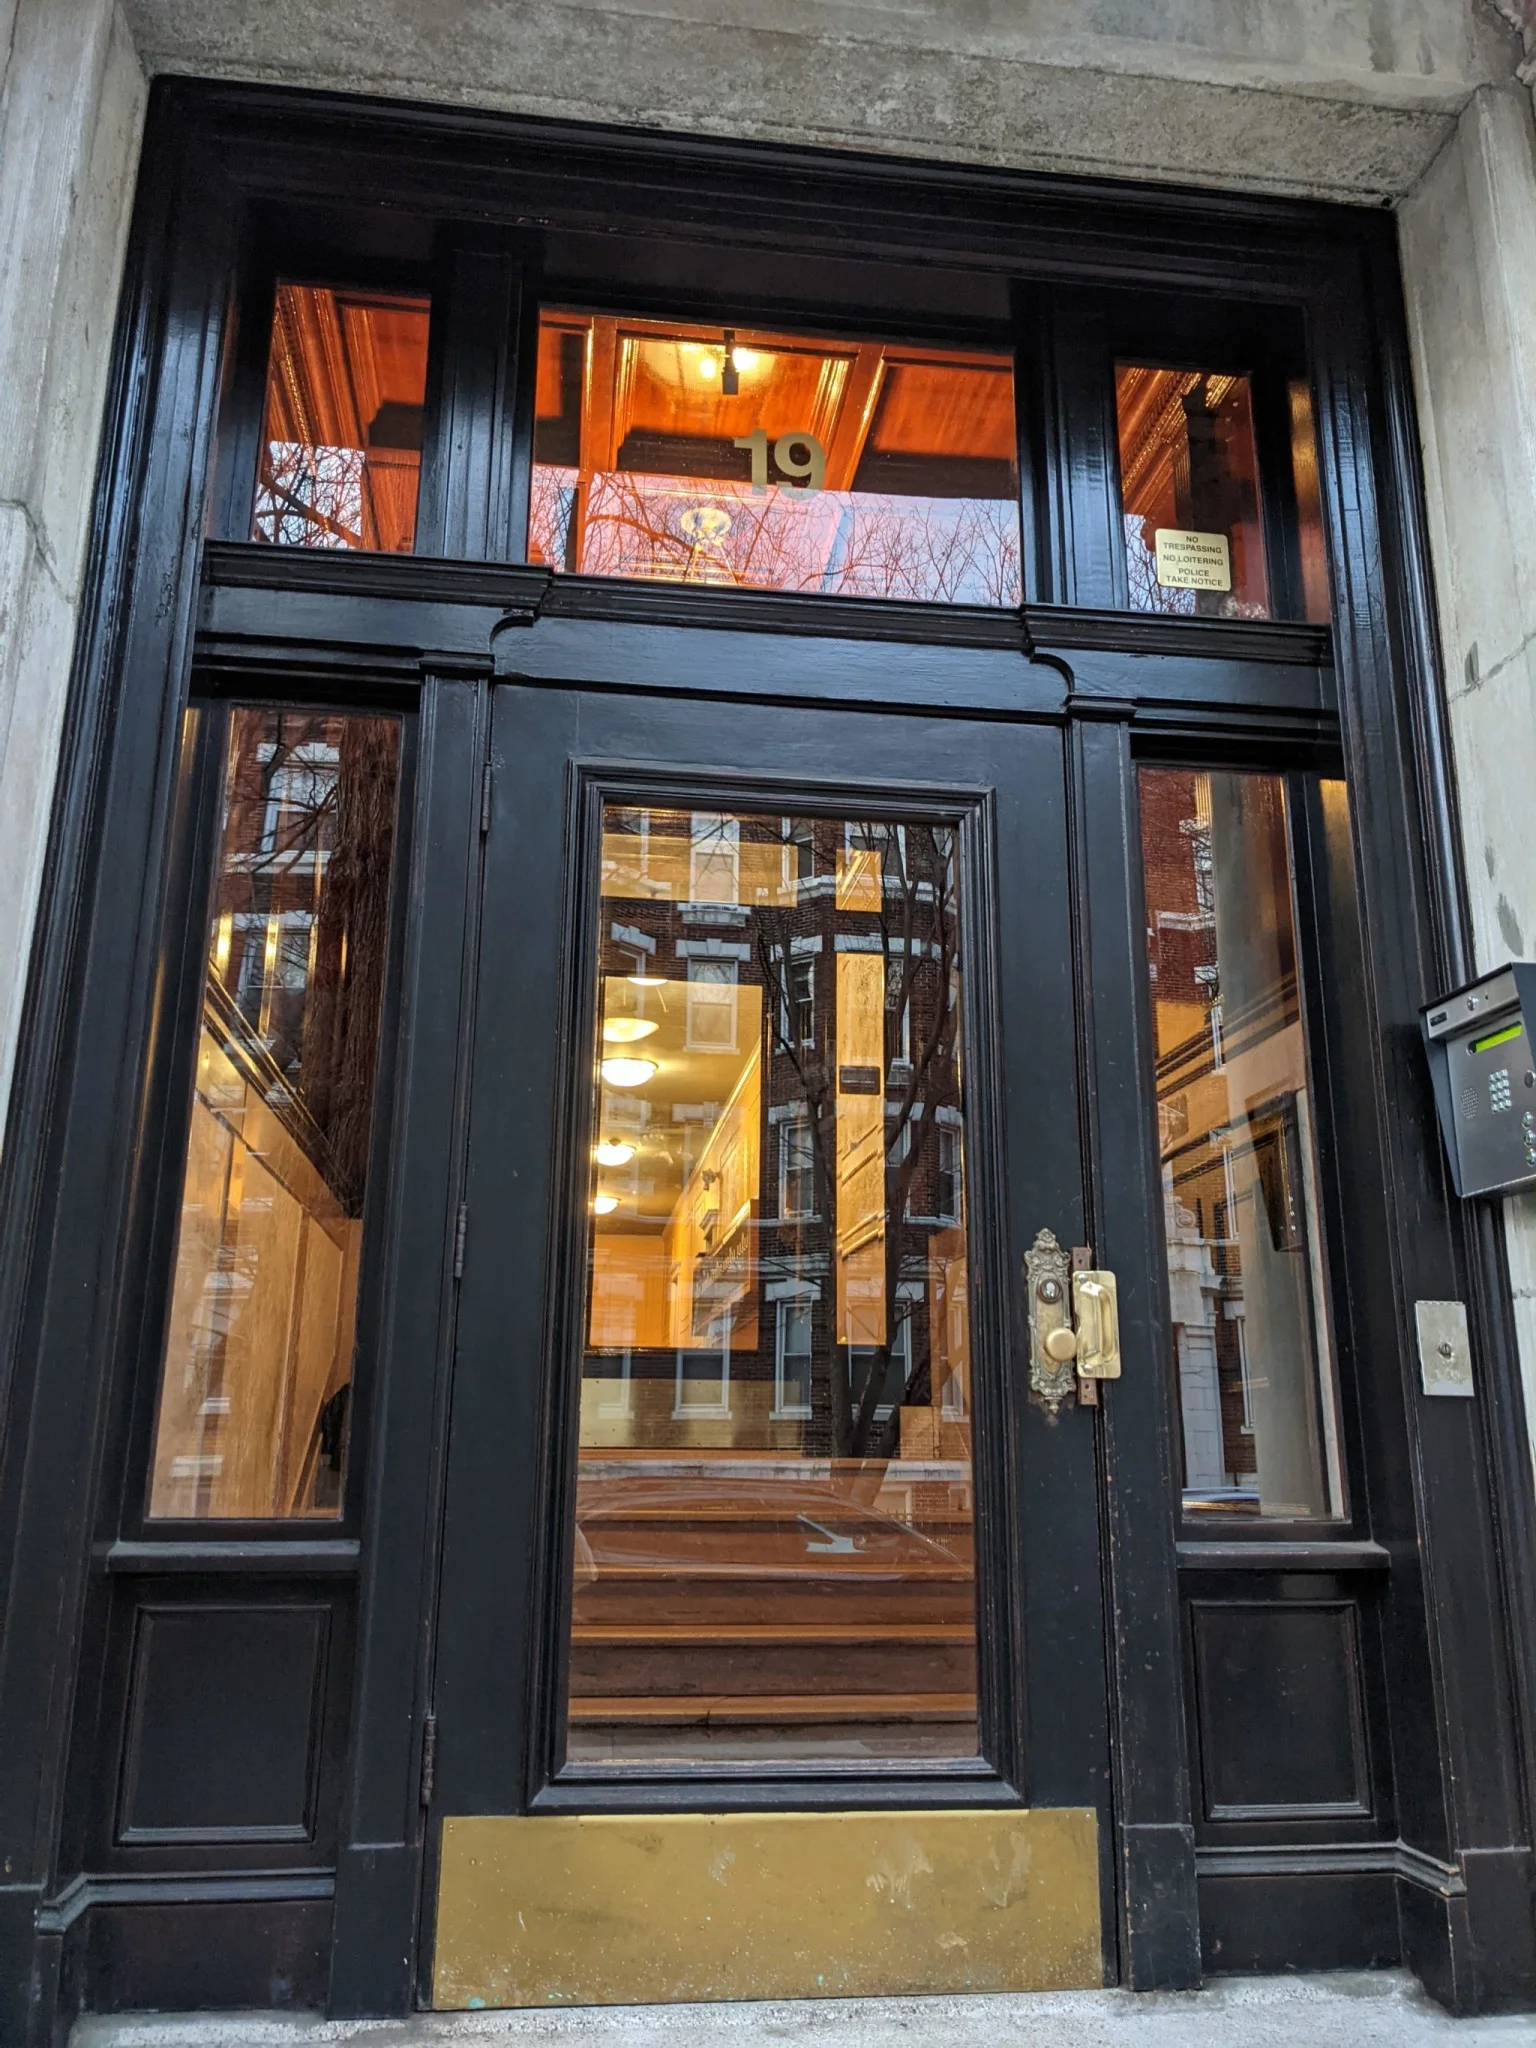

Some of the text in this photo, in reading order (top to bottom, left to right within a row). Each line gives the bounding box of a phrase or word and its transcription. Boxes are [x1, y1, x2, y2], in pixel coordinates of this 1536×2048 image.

[733, 427, 827, 500] 19
[1186, 535, 1199, 543] NO
[1163, 542, 1222, 553] TRESPASSING
[1163, 554, 1224, 566] NO LOITERING
[1178, 567, 1210, 577] POLICE
[1166, 575, 1224, 587] TAKE NOTICE
